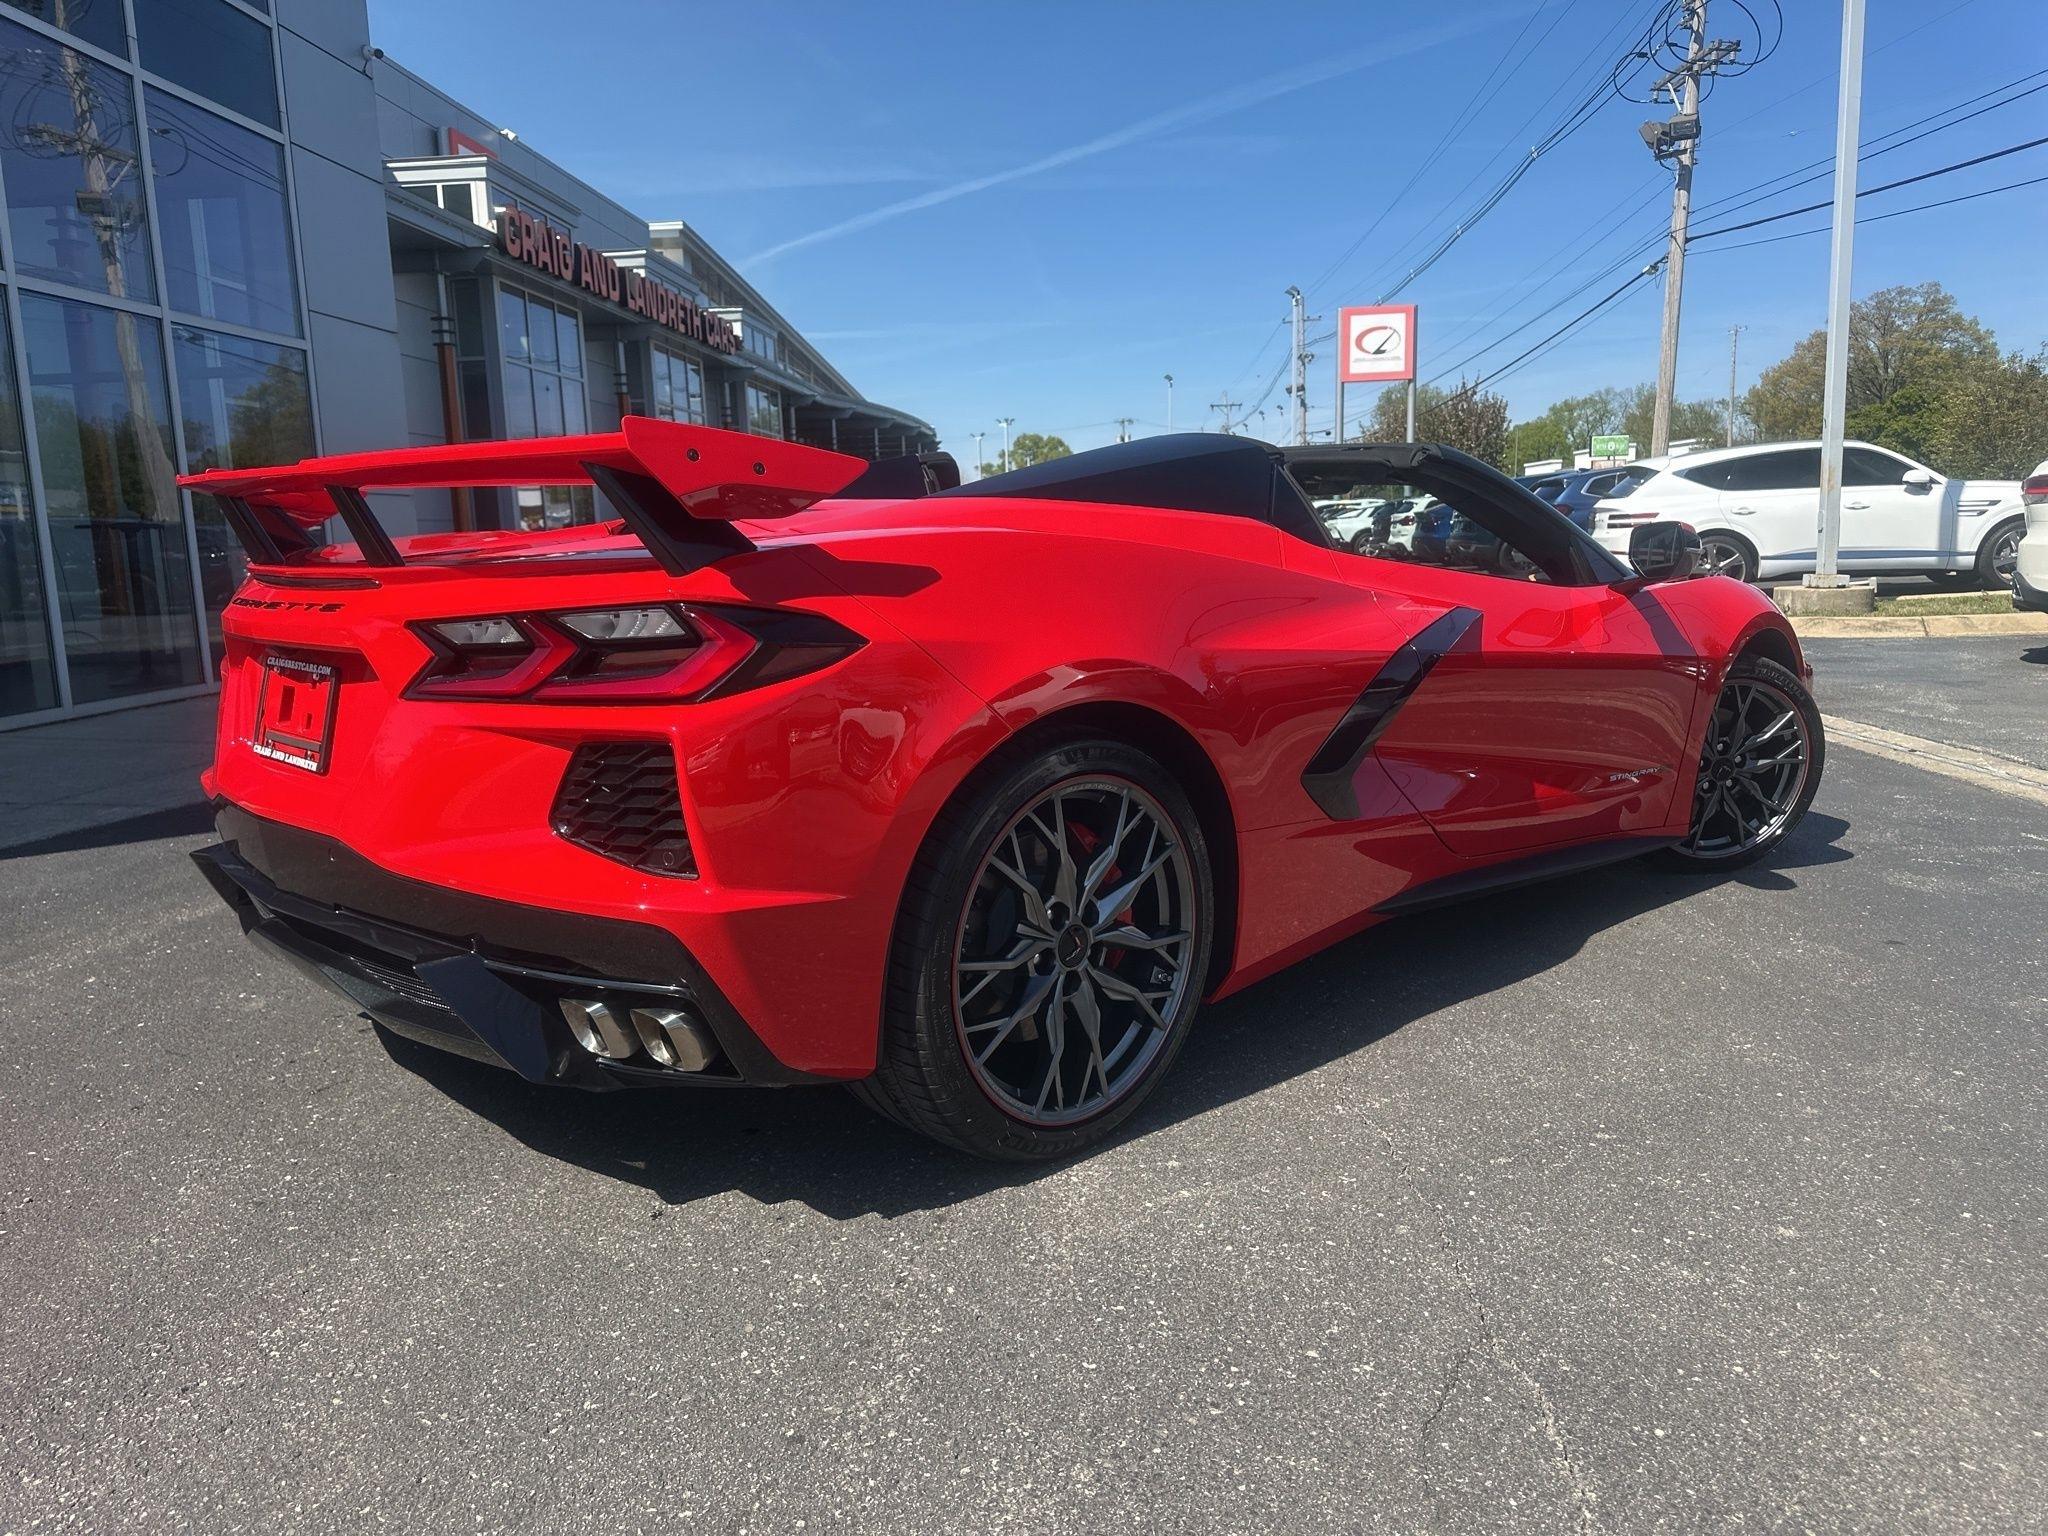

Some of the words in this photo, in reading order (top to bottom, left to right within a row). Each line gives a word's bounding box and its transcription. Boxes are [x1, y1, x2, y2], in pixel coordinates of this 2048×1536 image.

[504, 204, 575, 282] CRAIG
[580, 243, 621, 302] AND
[625, 266, 703, 342] LANDRETH
[704, 310, 737, 356] CARS
[1609, 767, 1660, 782] STINGRAY
